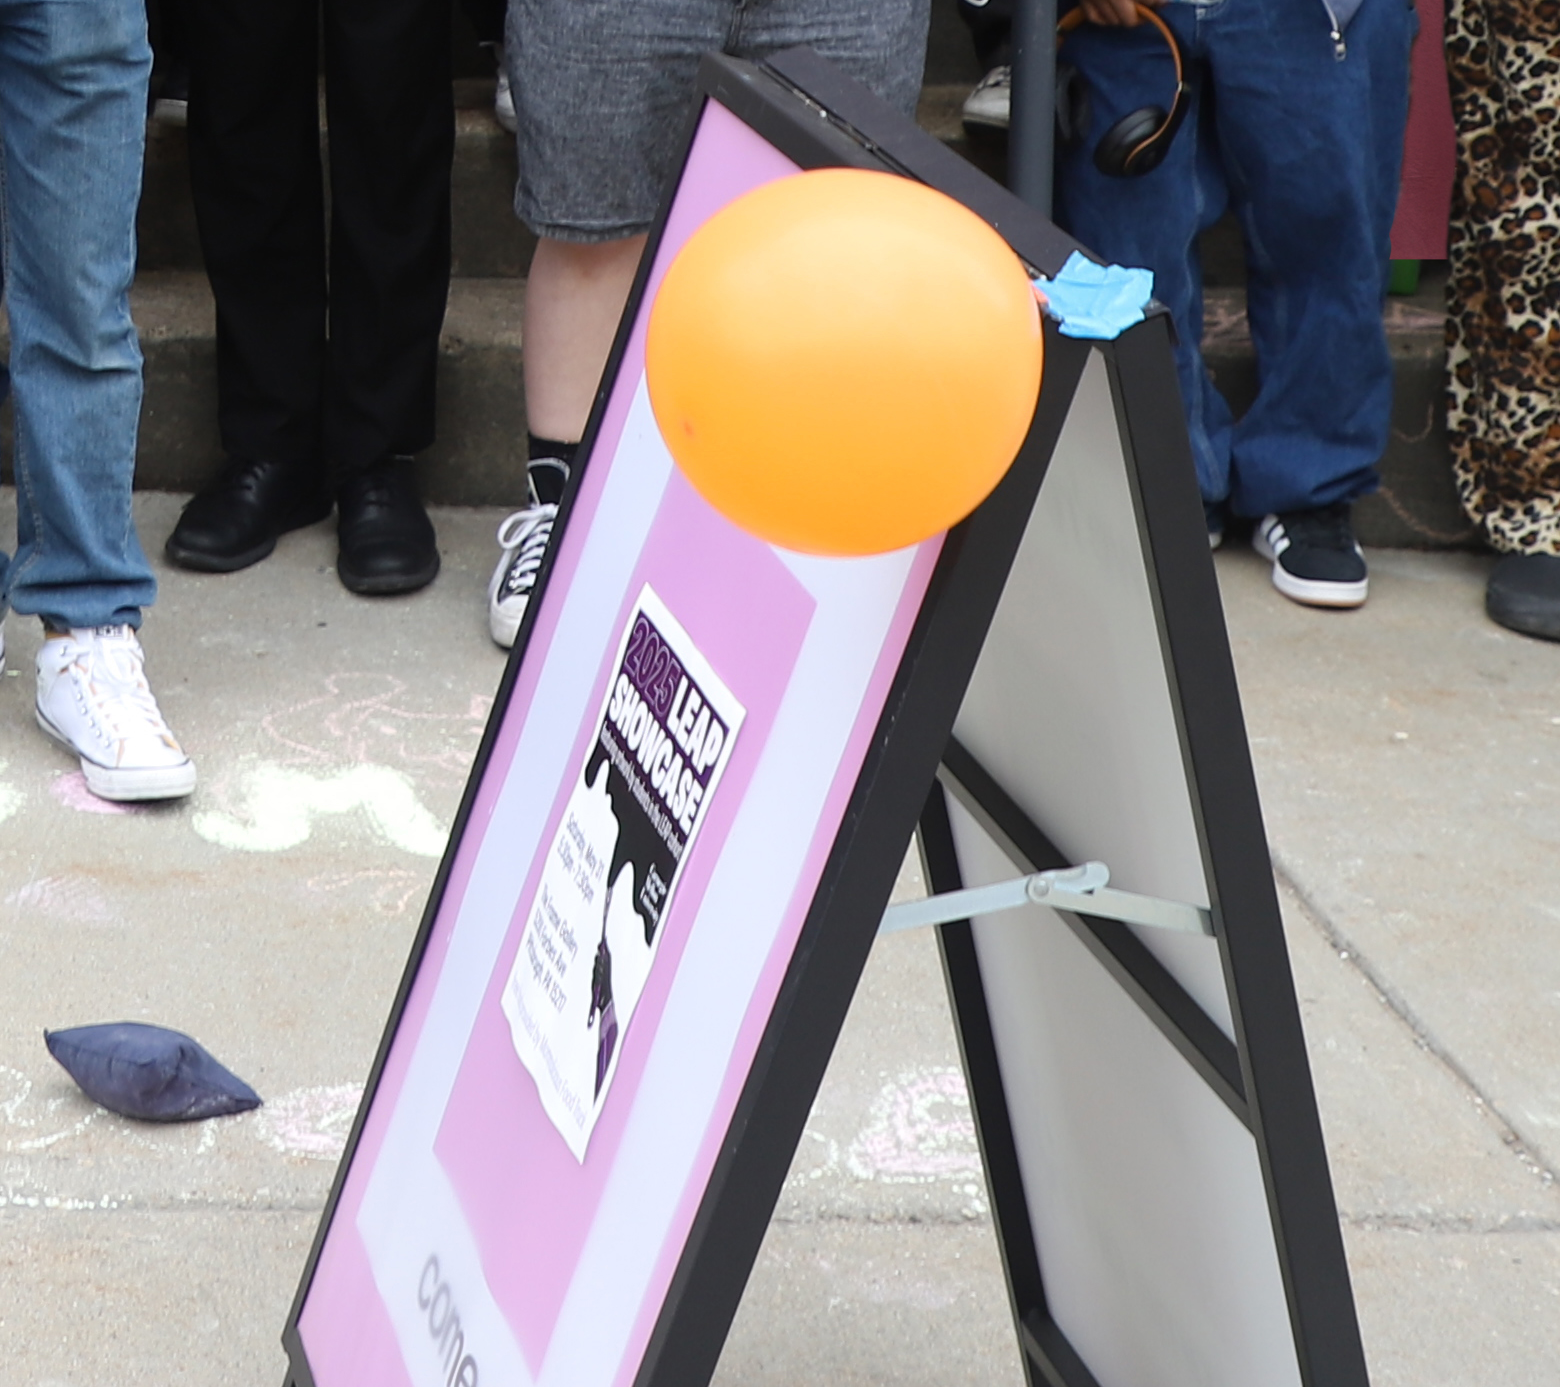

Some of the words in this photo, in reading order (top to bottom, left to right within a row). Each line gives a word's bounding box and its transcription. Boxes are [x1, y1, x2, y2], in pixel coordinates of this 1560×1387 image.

[608, 672, 704, 836] SHOWCASE
[625, 616, 681, 718] 2025
[666, 674, 725, 776] LEAP
[584, 842, 598, 874] May
